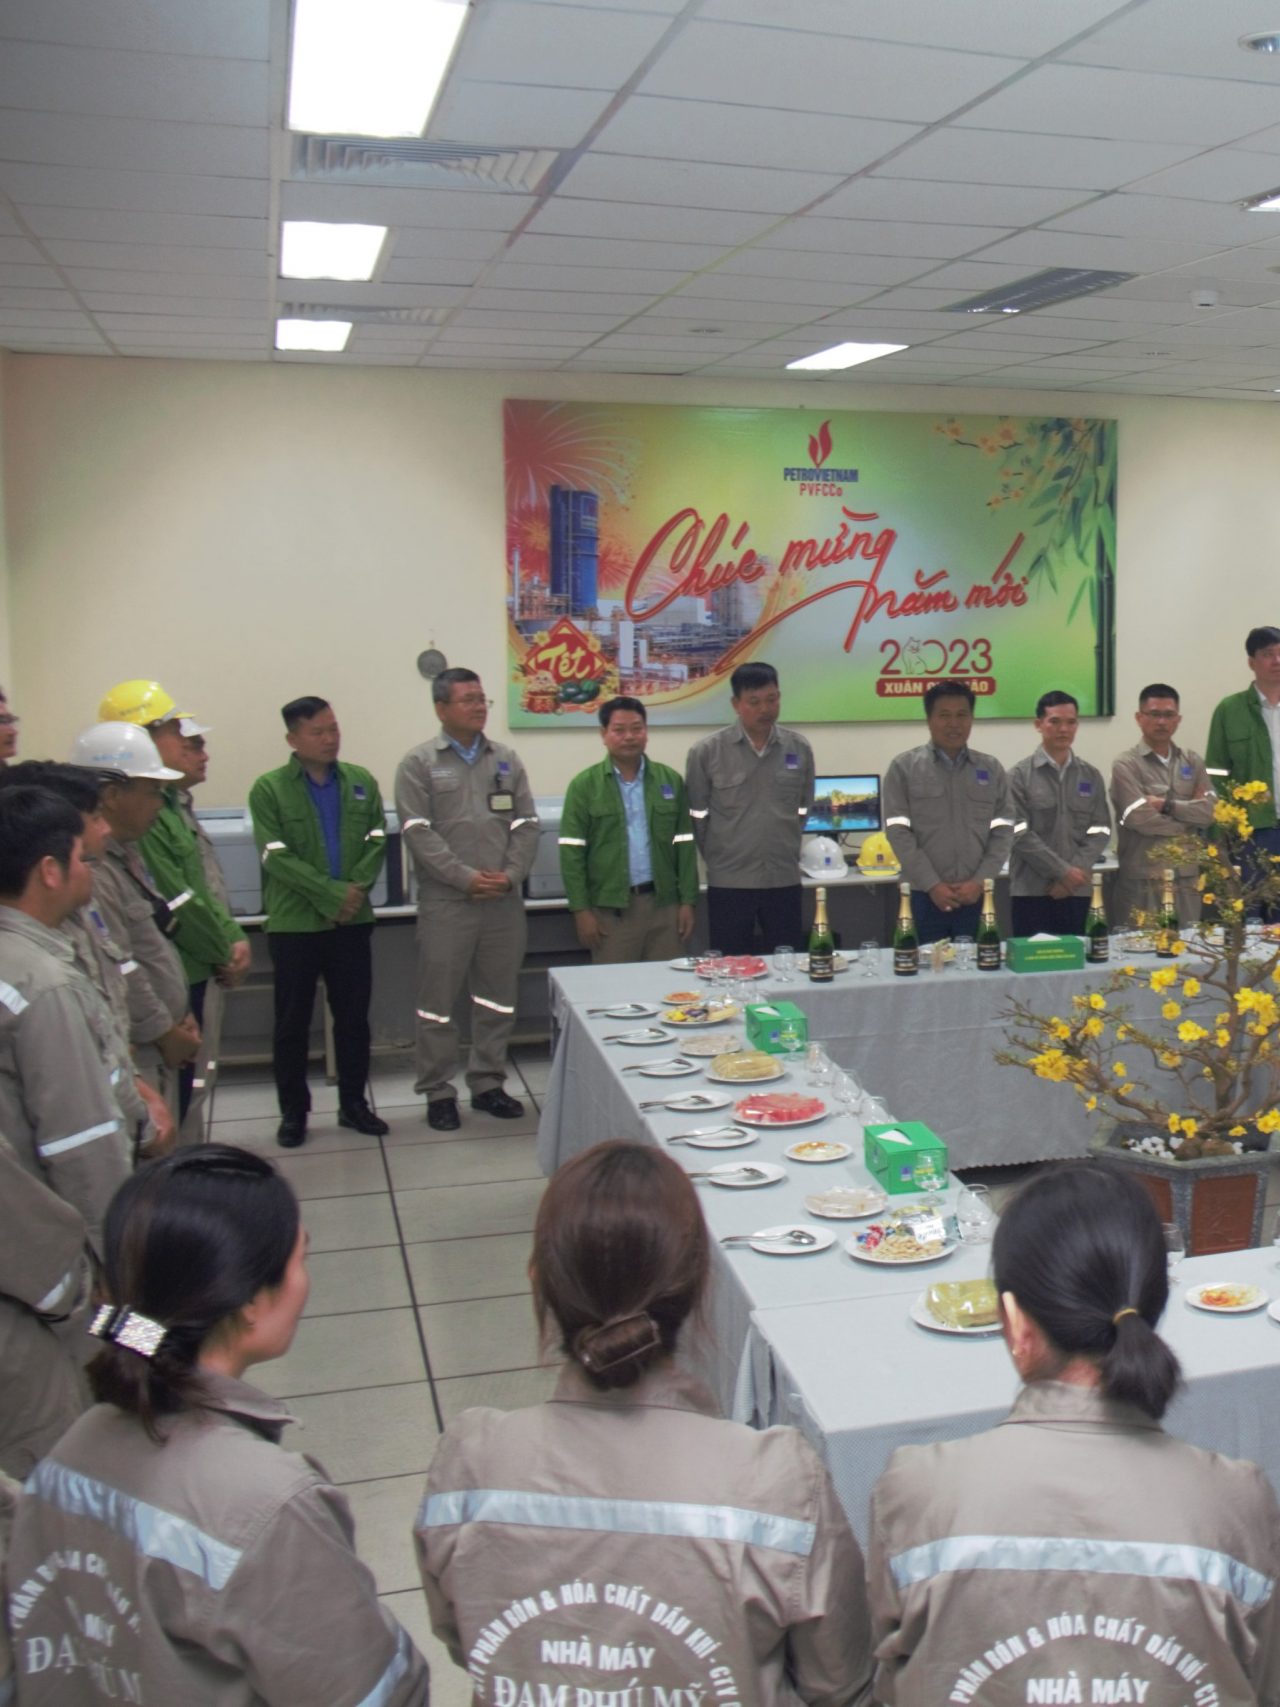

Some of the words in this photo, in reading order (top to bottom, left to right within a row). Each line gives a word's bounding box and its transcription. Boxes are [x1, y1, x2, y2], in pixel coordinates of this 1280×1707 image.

[783, 467, 859, 483] PETROVIETNAM
[799, 483, 844, 497] PVFCCo
[625, 507, 766, 624] Chúc
[963, 531, 1030, 610] mới
[536, 641, 592, 679] Tết
[879, 637, 993, 675] 2023
[884, 680, 923, 694] XUÂN
[541, 1634, 593, 1668] NHÀ
[598, 1640, 656, 1672] MÁY
[1026, 1669, 1083, 1705] NHÀ
[1091, 1671, 1151, 1705] MÁY
